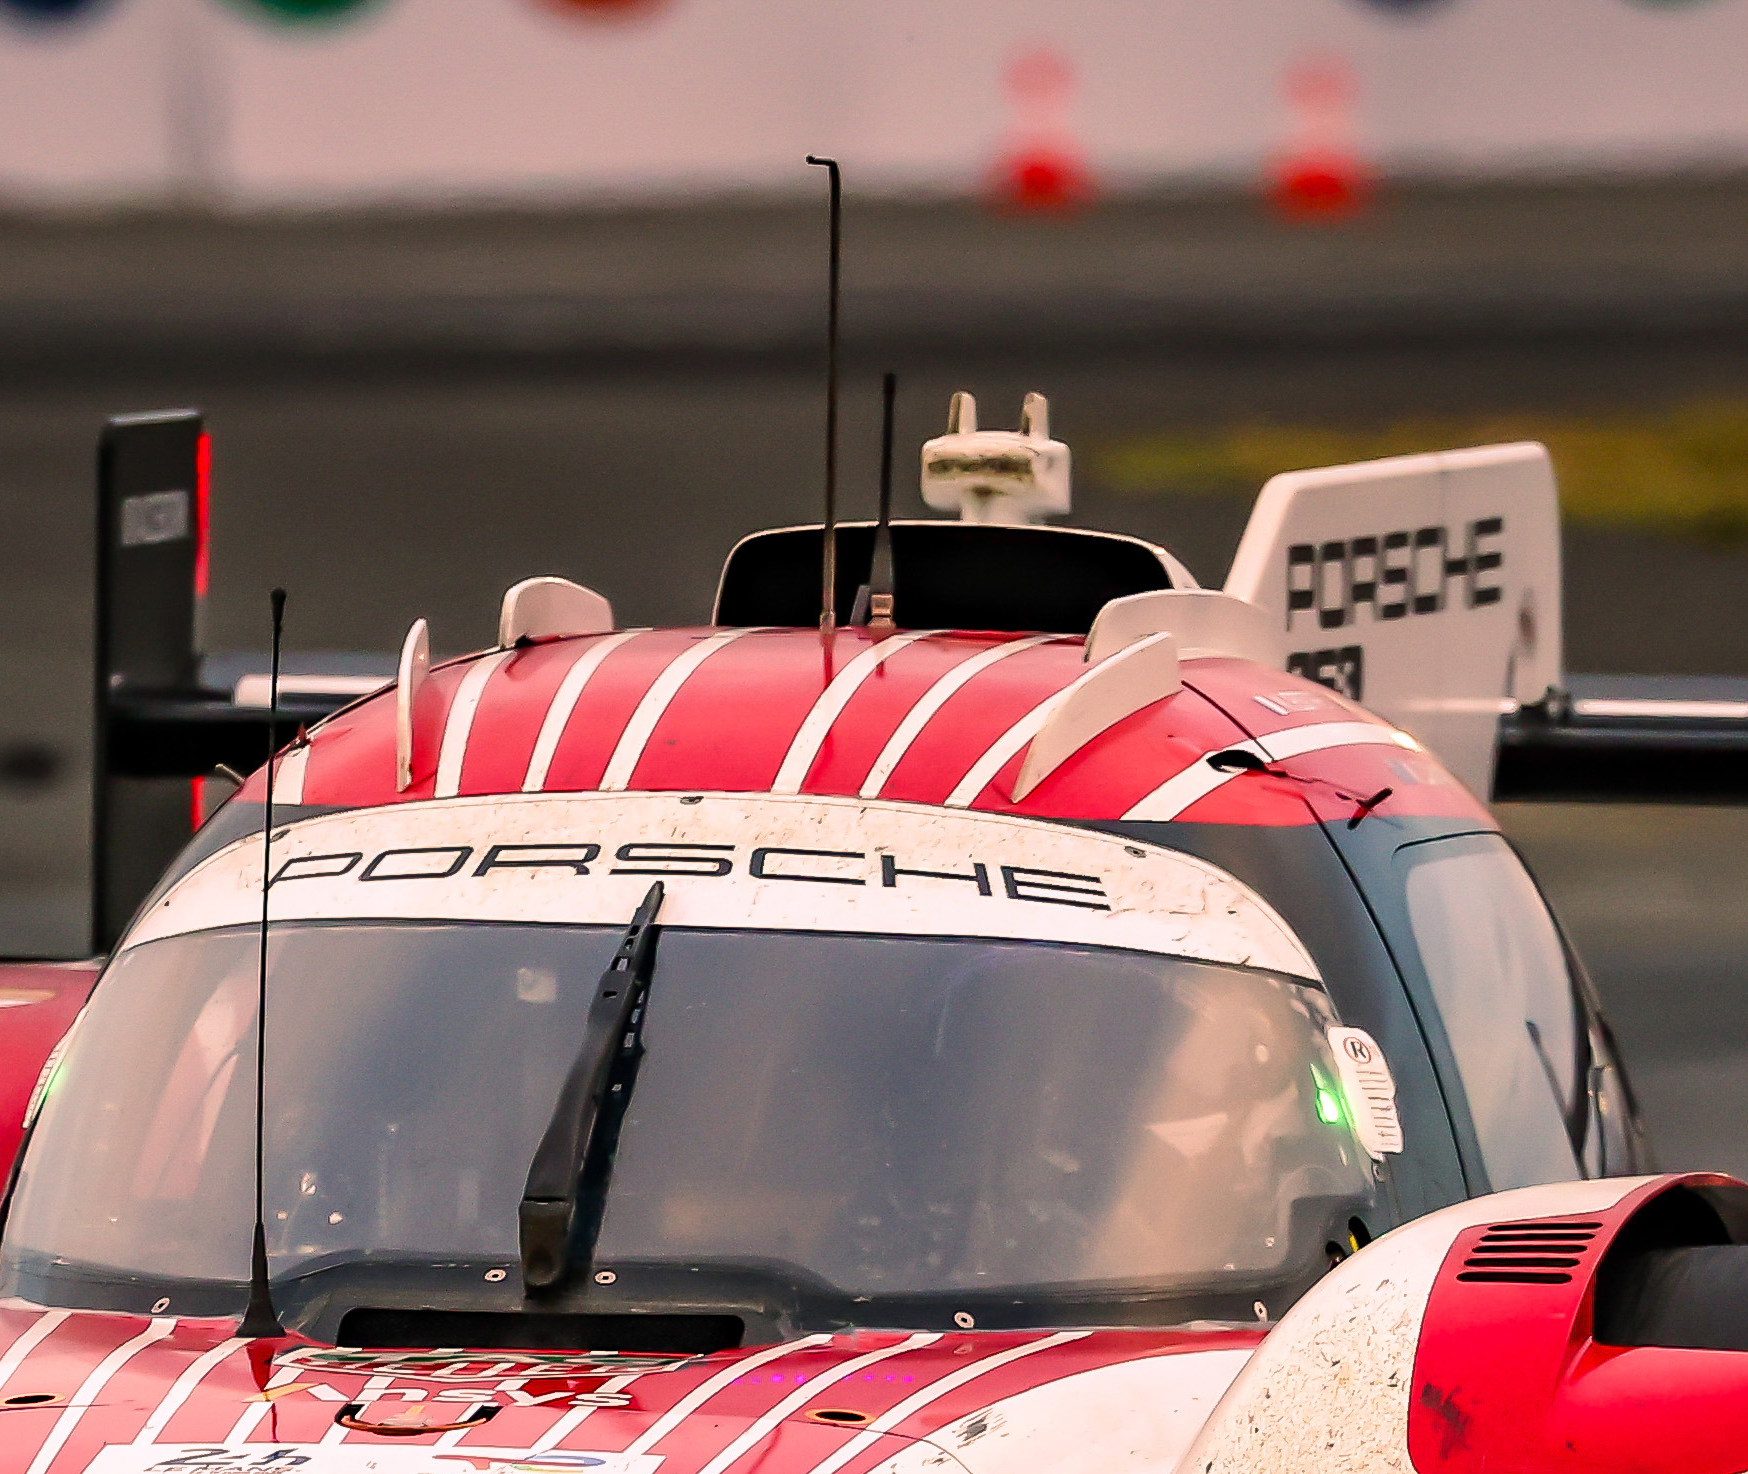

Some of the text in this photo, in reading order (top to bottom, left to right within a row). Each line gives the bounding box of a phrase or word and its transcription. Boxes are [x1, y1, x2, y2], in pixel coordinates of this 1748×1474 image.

[1286, 516, 1503, 633] PORSCHE
[265, 842, 1113, 911] PORSCHE
[243, 1382, 634, 1408] Ansys
